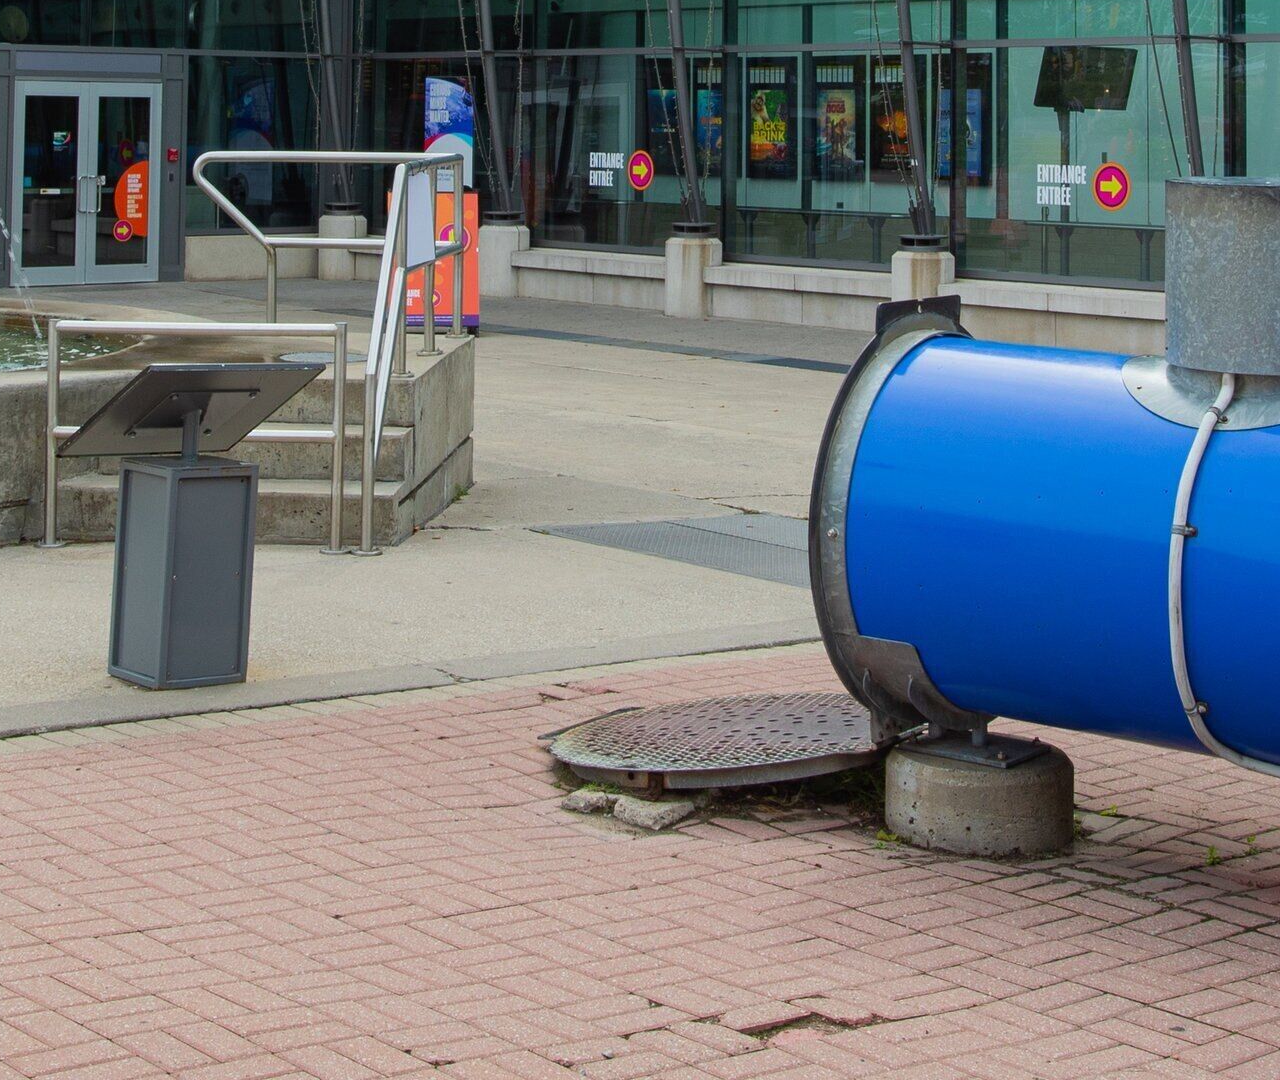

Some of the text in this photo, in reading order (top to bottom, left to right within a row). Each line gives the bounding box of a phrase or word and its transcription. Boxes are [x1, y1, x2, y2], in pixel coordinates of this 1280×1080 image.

[754, 121, 776, 131] BACK
[589, 152, 624, 169] ENTRANCE
[589, 169, 614, 187] ENTRÉE
[1037, 164, 1087, 185] ENTRANCE
[1036, 184, 1071, 206] ENTRÉE
